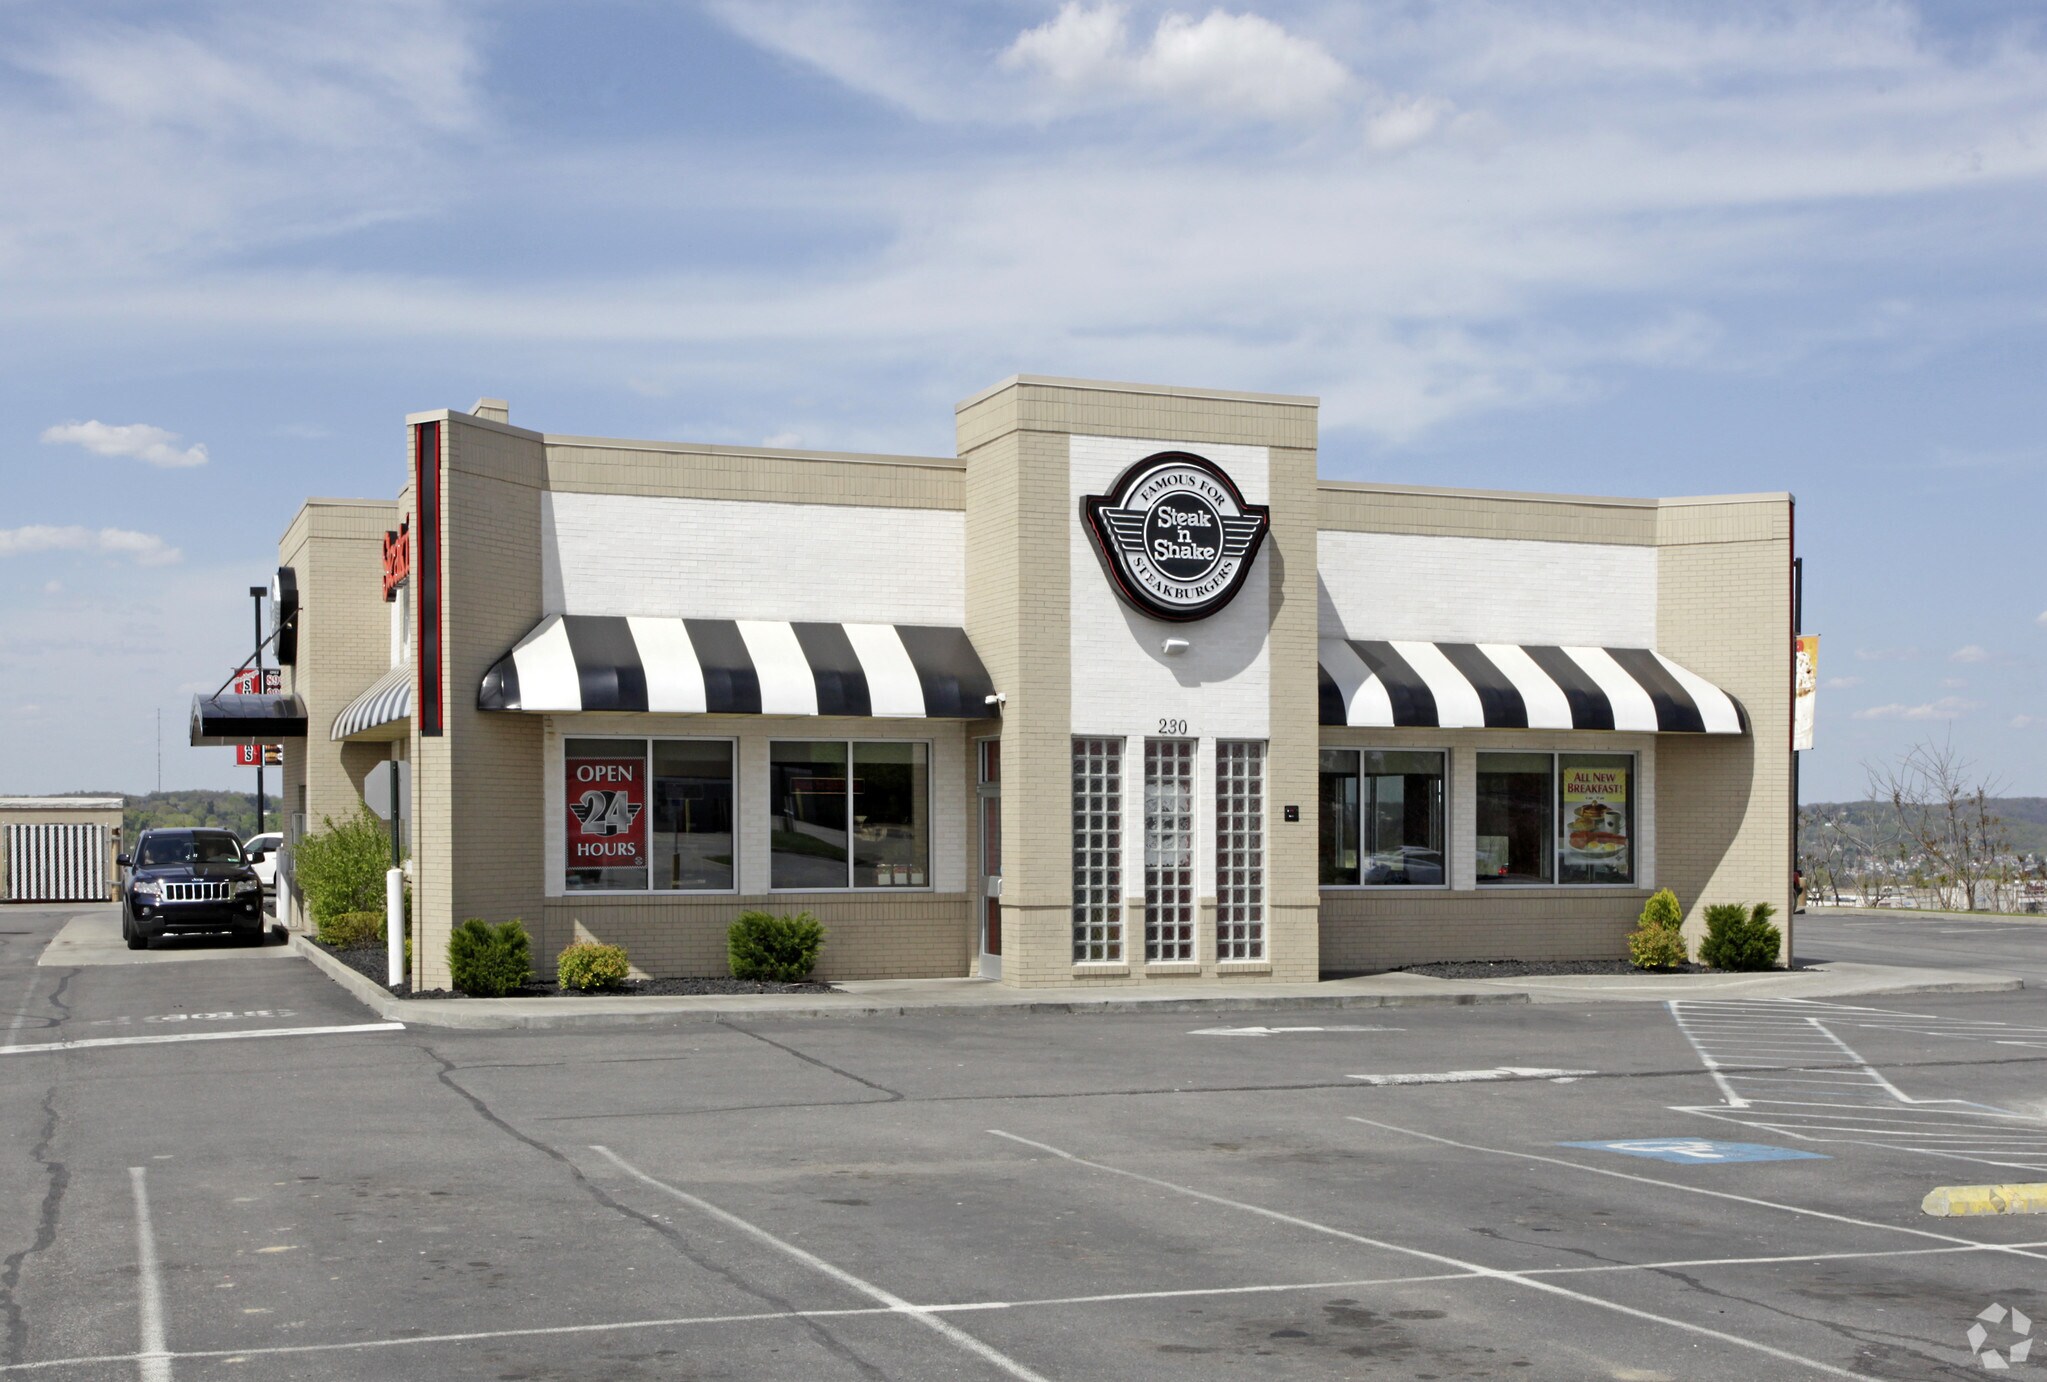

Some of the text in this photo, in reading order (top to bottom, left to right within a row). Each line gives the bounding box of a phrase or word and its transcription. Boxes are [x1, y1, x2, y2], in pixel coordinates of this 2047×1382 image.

[1141, 474, 1226, 507] FAMOUS FOR
[1157, 506, 1211, 528] Steak
[1154, 539, 1215, 561] Shake
[1133, 557, 1233, 599] STEAKBURGERS
[1158, 718, 1188, 735] 230
[576, 765, 633, 782] OPEN
[1573, 772, 1616, 782] ALL NEW
[1567, 782, 1623, 794] BREAKFAST!
[579, 790, 633, 834] 24
[577, 842, 636, 857] HOURS
